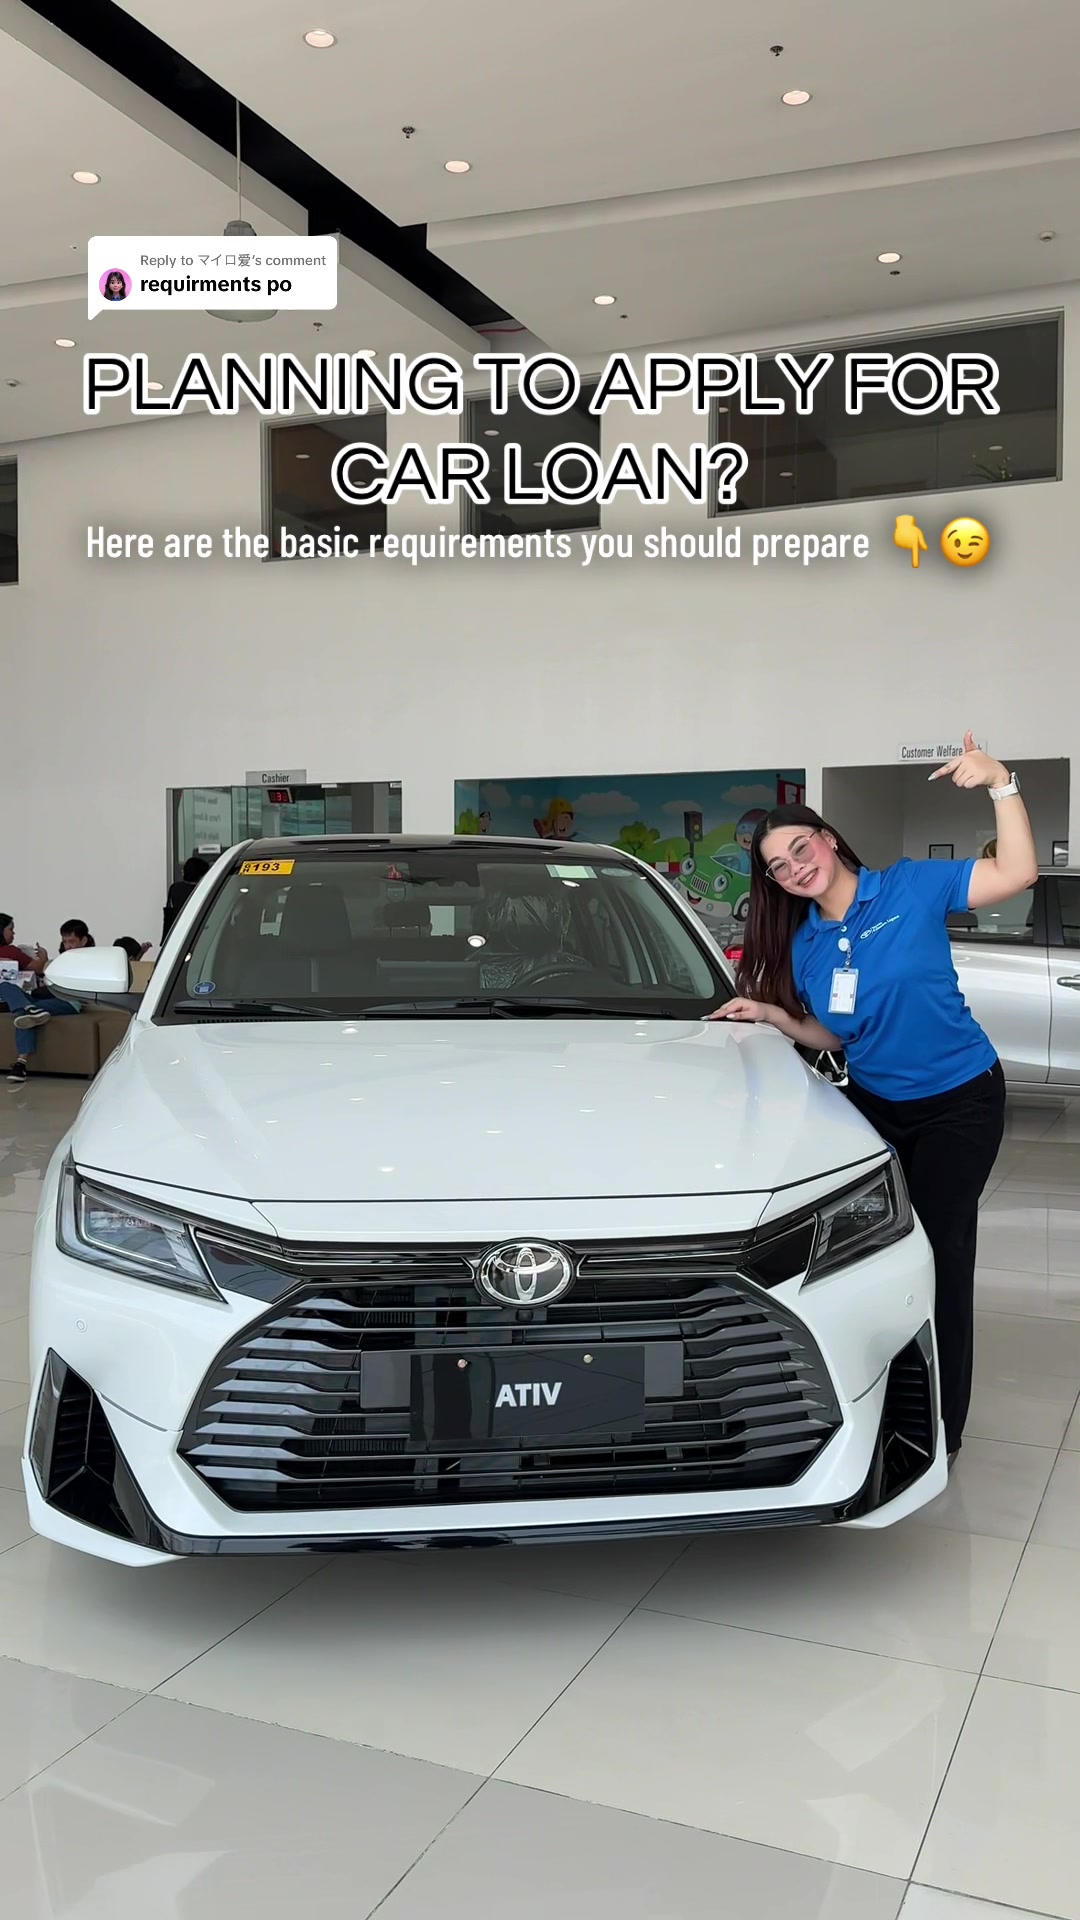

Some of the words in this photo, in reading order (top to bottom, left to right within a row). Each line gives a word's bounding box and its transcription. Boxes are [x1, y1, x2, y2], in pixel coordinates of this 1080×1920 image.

[901, 747, 934, 758] Customer
[936, 745, 963, 757] Welfare
[261, 773, 289, 784] Cashier
[253, 862, 280, 871] 193
[495, 1382, 562, 1408] ATIV
